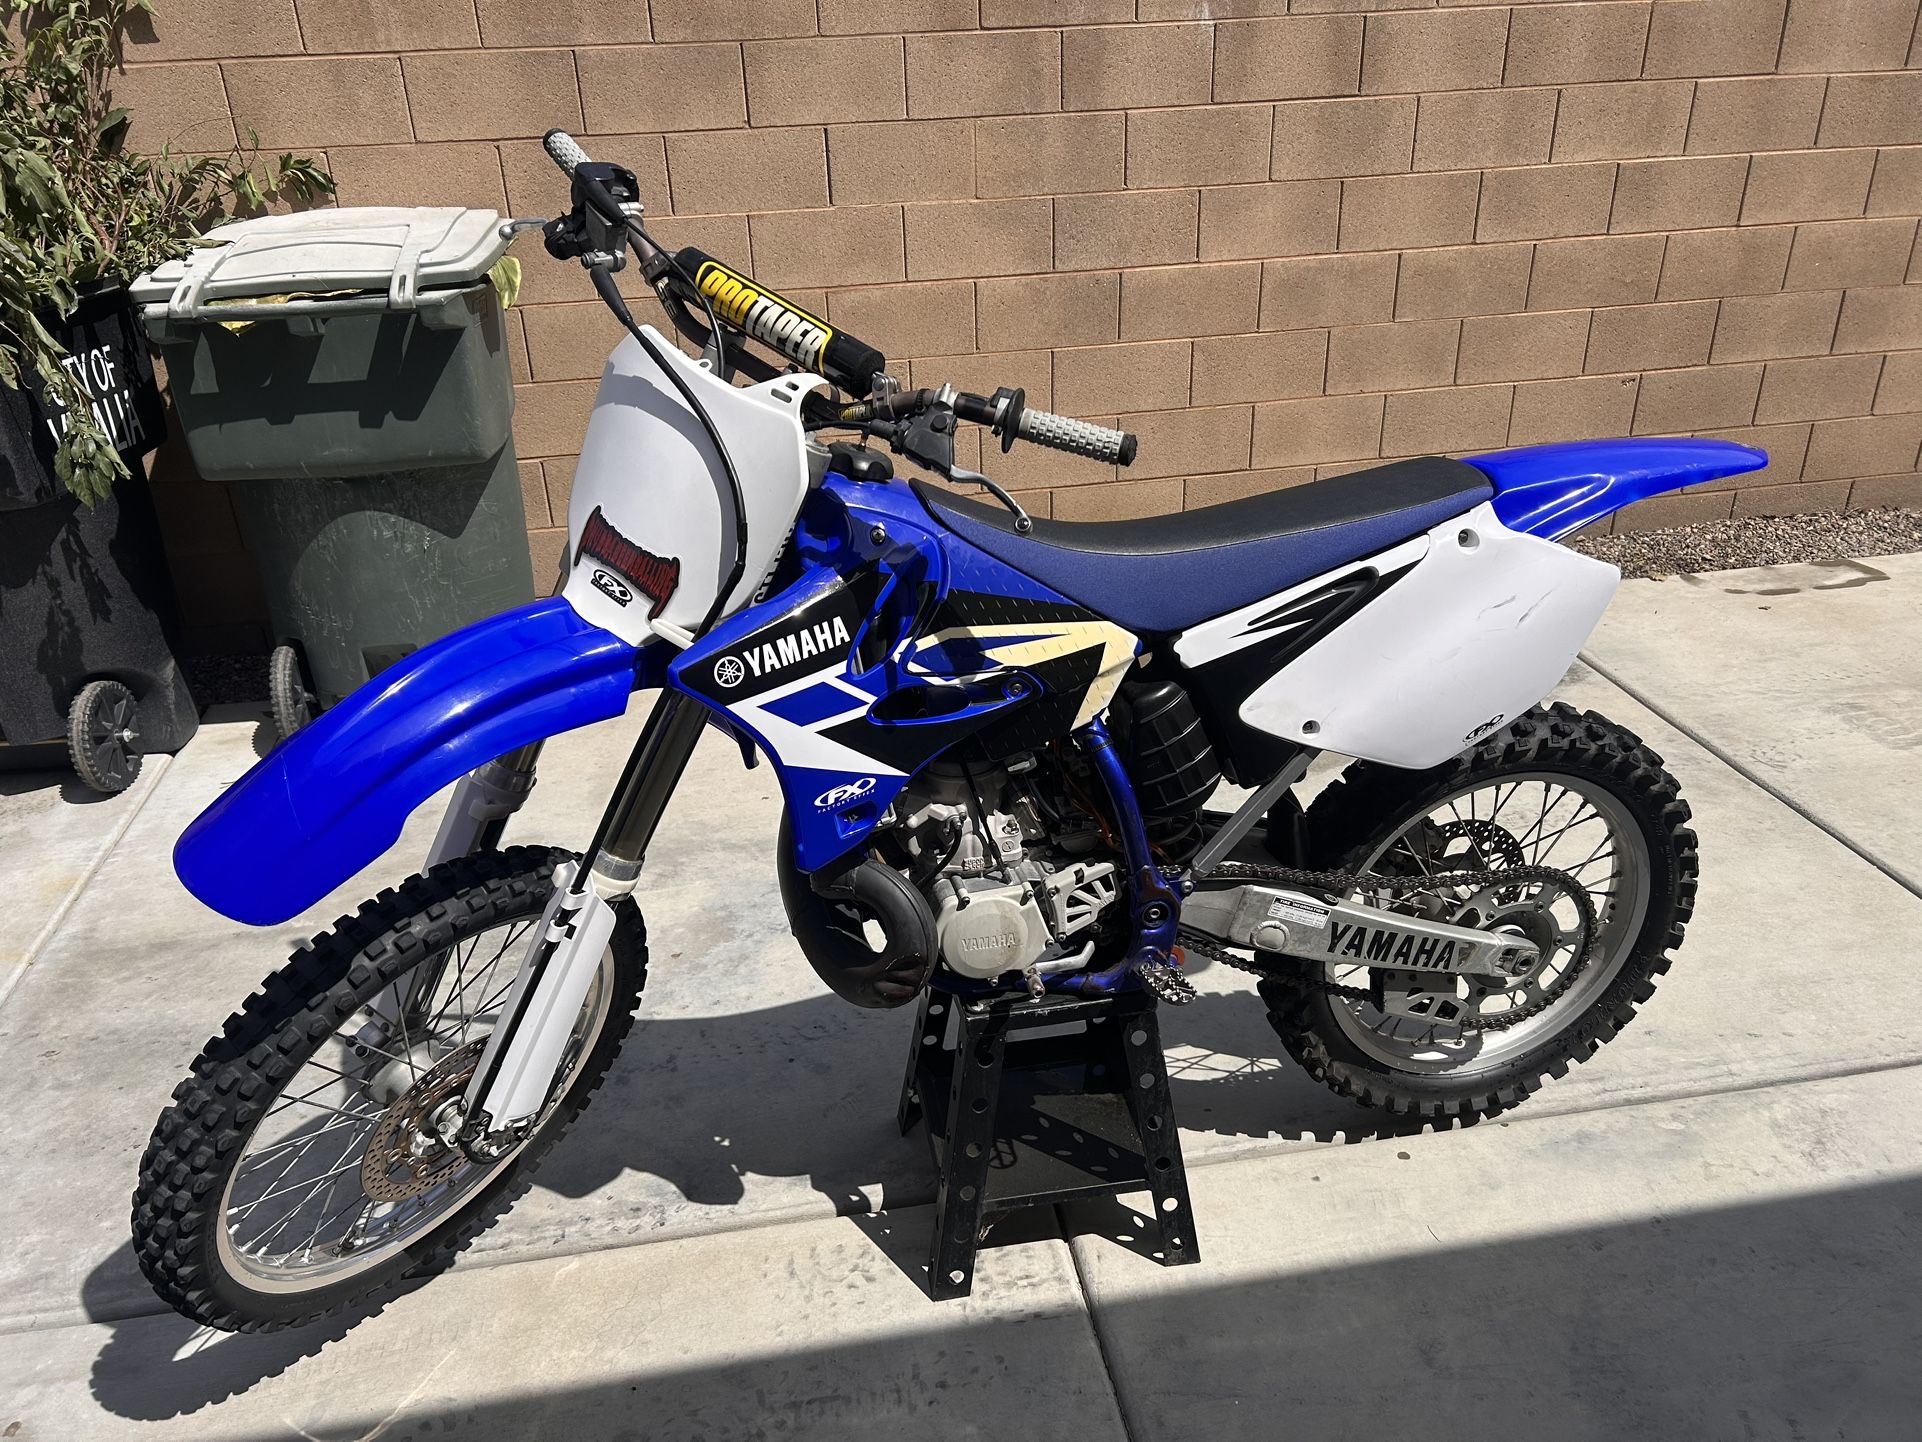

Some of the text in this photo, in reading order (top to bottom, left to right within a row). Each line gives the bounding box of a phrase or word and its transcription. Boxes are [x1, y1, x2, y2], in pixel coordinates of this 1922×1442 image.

[91, 345, 116, 391] OF
[47, 389, 146, 452] VALIA
[742, 616, 850, 677] YAMAHA
[817, 797, 850, 814] FACTORY
[961, 932, 1016, 952] YAMAHA
[1327, 921, 1458, 970] YAMAHA
